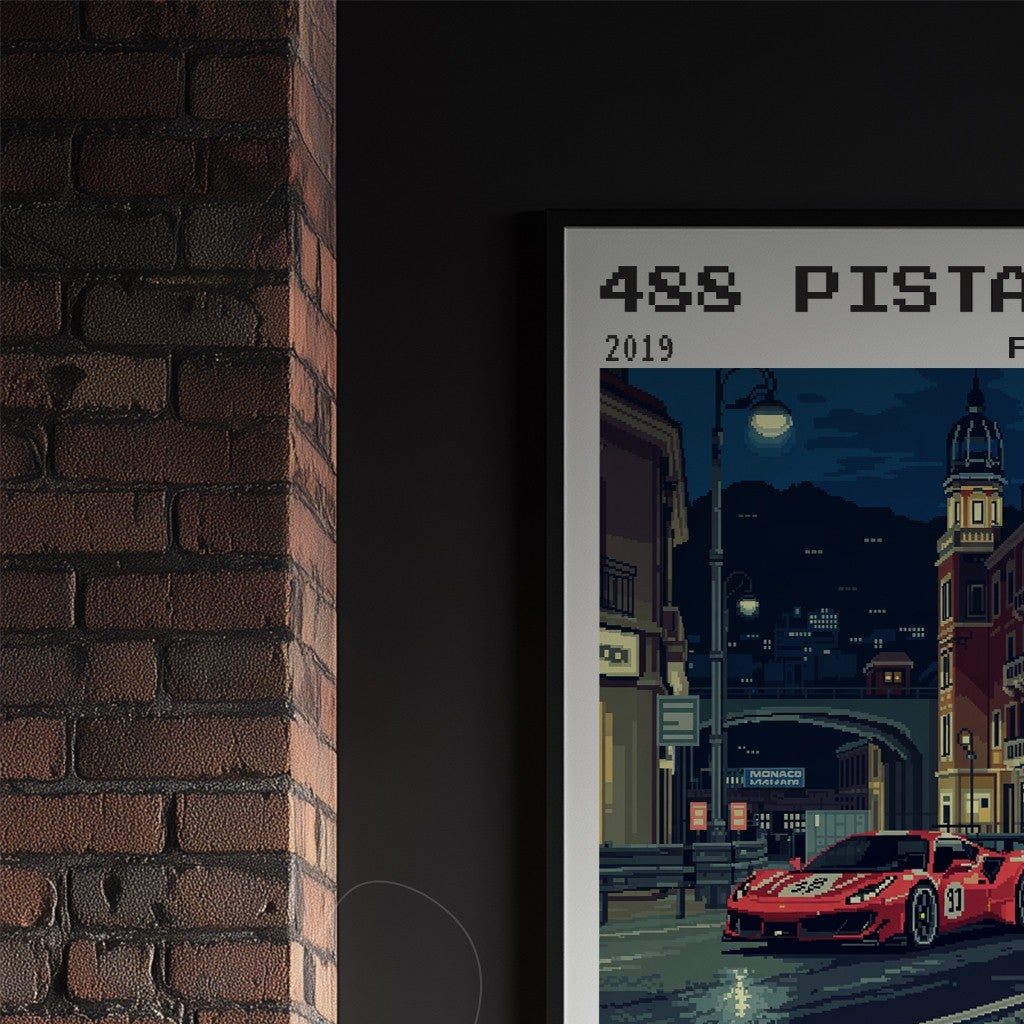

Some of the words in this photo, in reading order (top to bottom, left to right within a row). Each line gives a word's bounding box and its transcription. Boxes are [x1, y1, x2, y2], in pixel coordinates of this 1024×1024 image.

[600, 266, 741, 312] 488
[606, 335, 673, 361] 2019
[749, 770, 802, 778] MONACO
